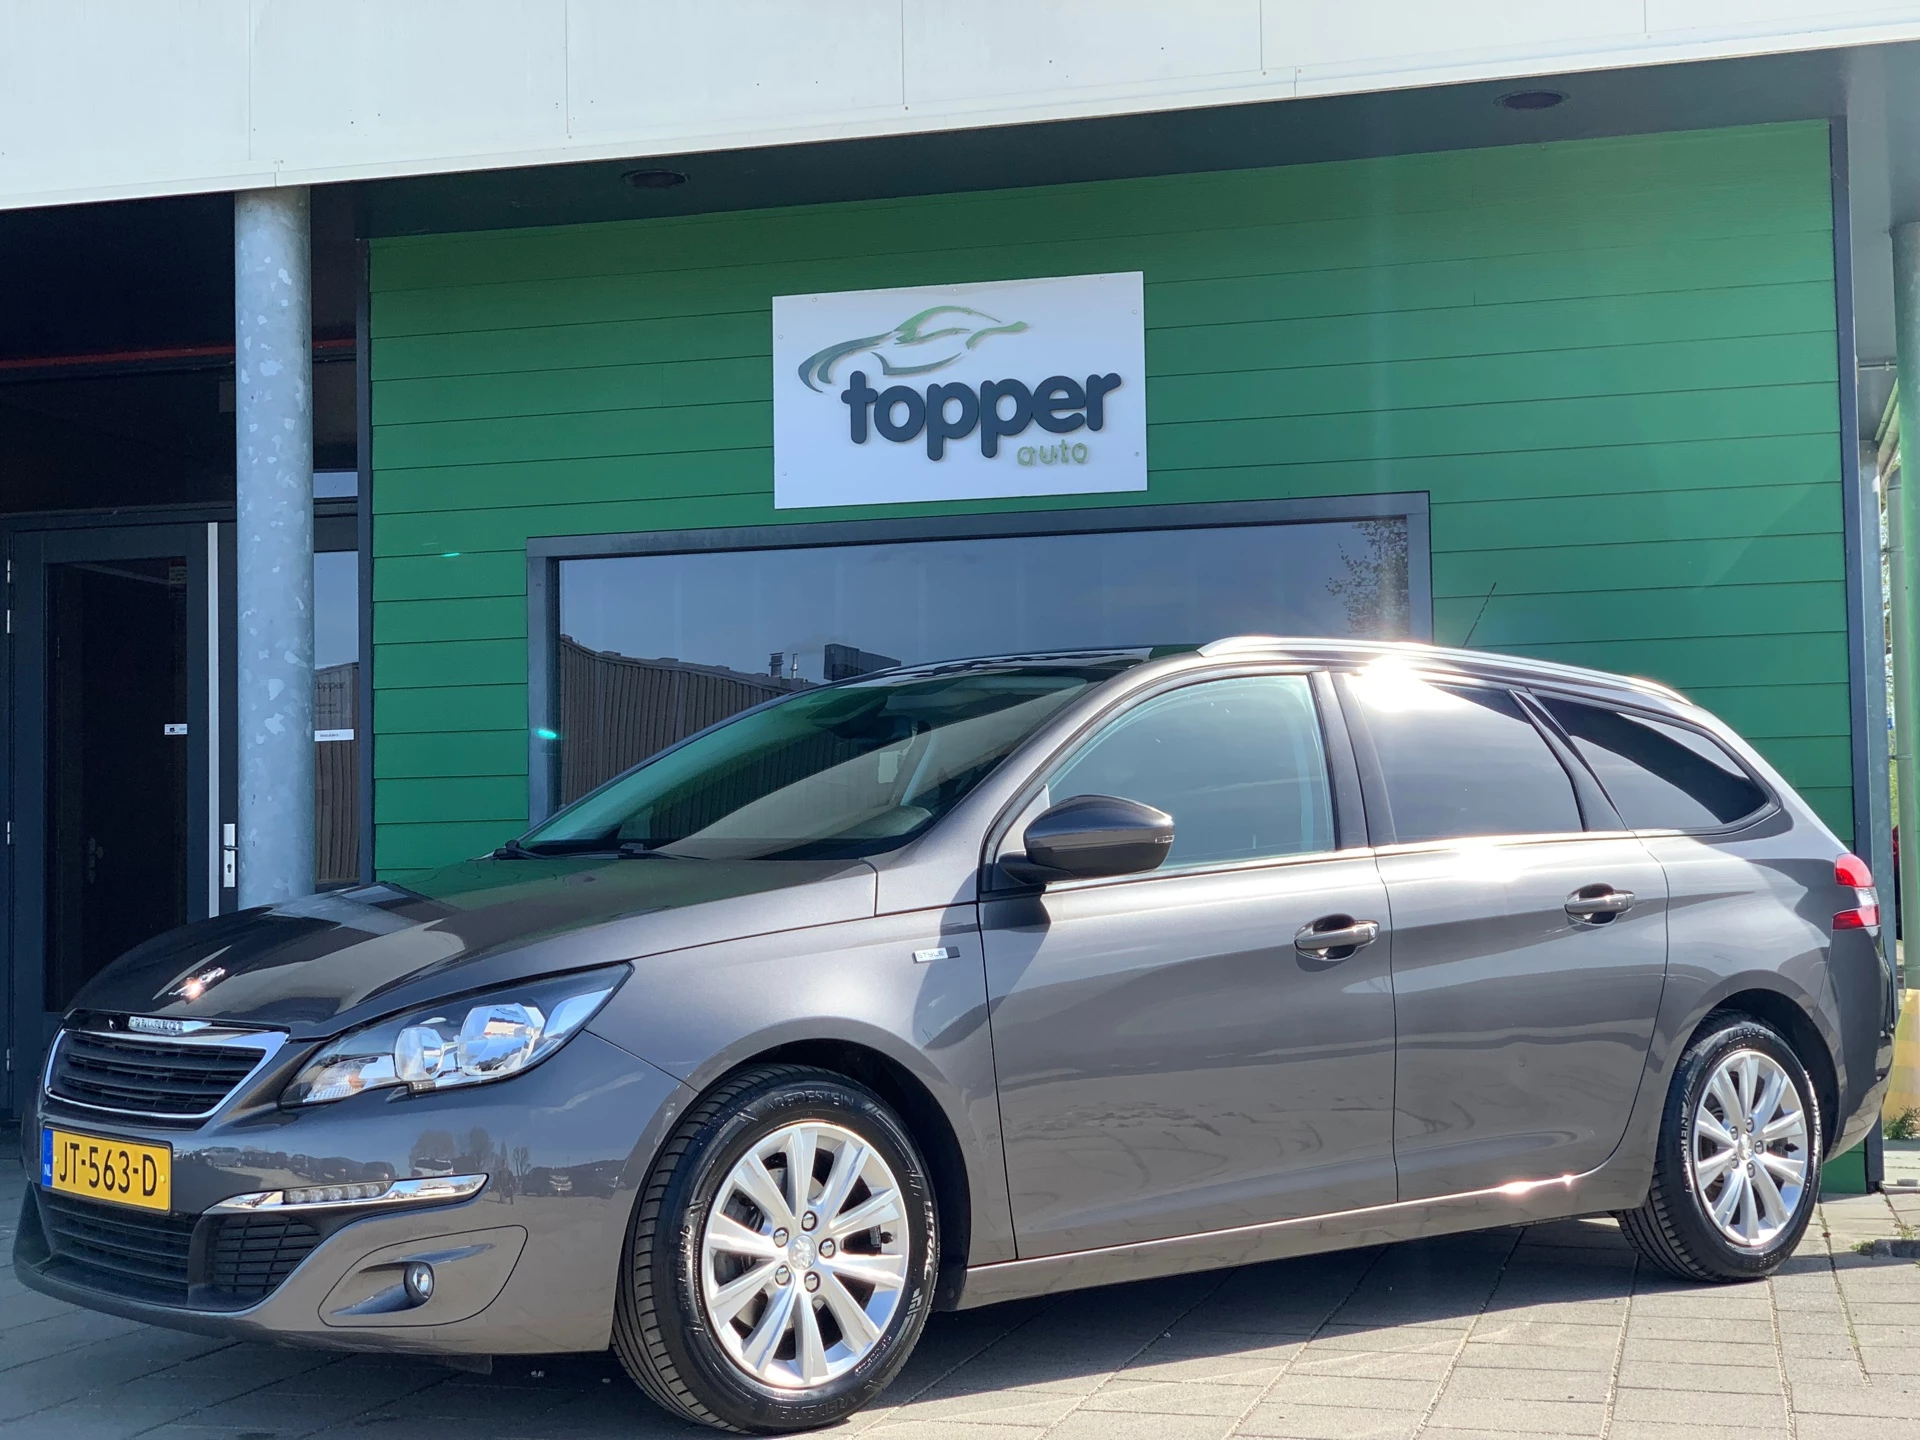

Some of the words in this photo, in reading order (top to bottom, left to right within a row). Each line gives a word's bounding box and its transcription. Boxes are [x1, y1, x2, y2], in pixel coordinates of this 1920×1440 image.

[841, 370, 1122, 461] topper
[1017, 440, 1089, 467] auto
[44, 1163, 52, 1177] NL
[59, 1141, 158, 1197] JT-563-D
